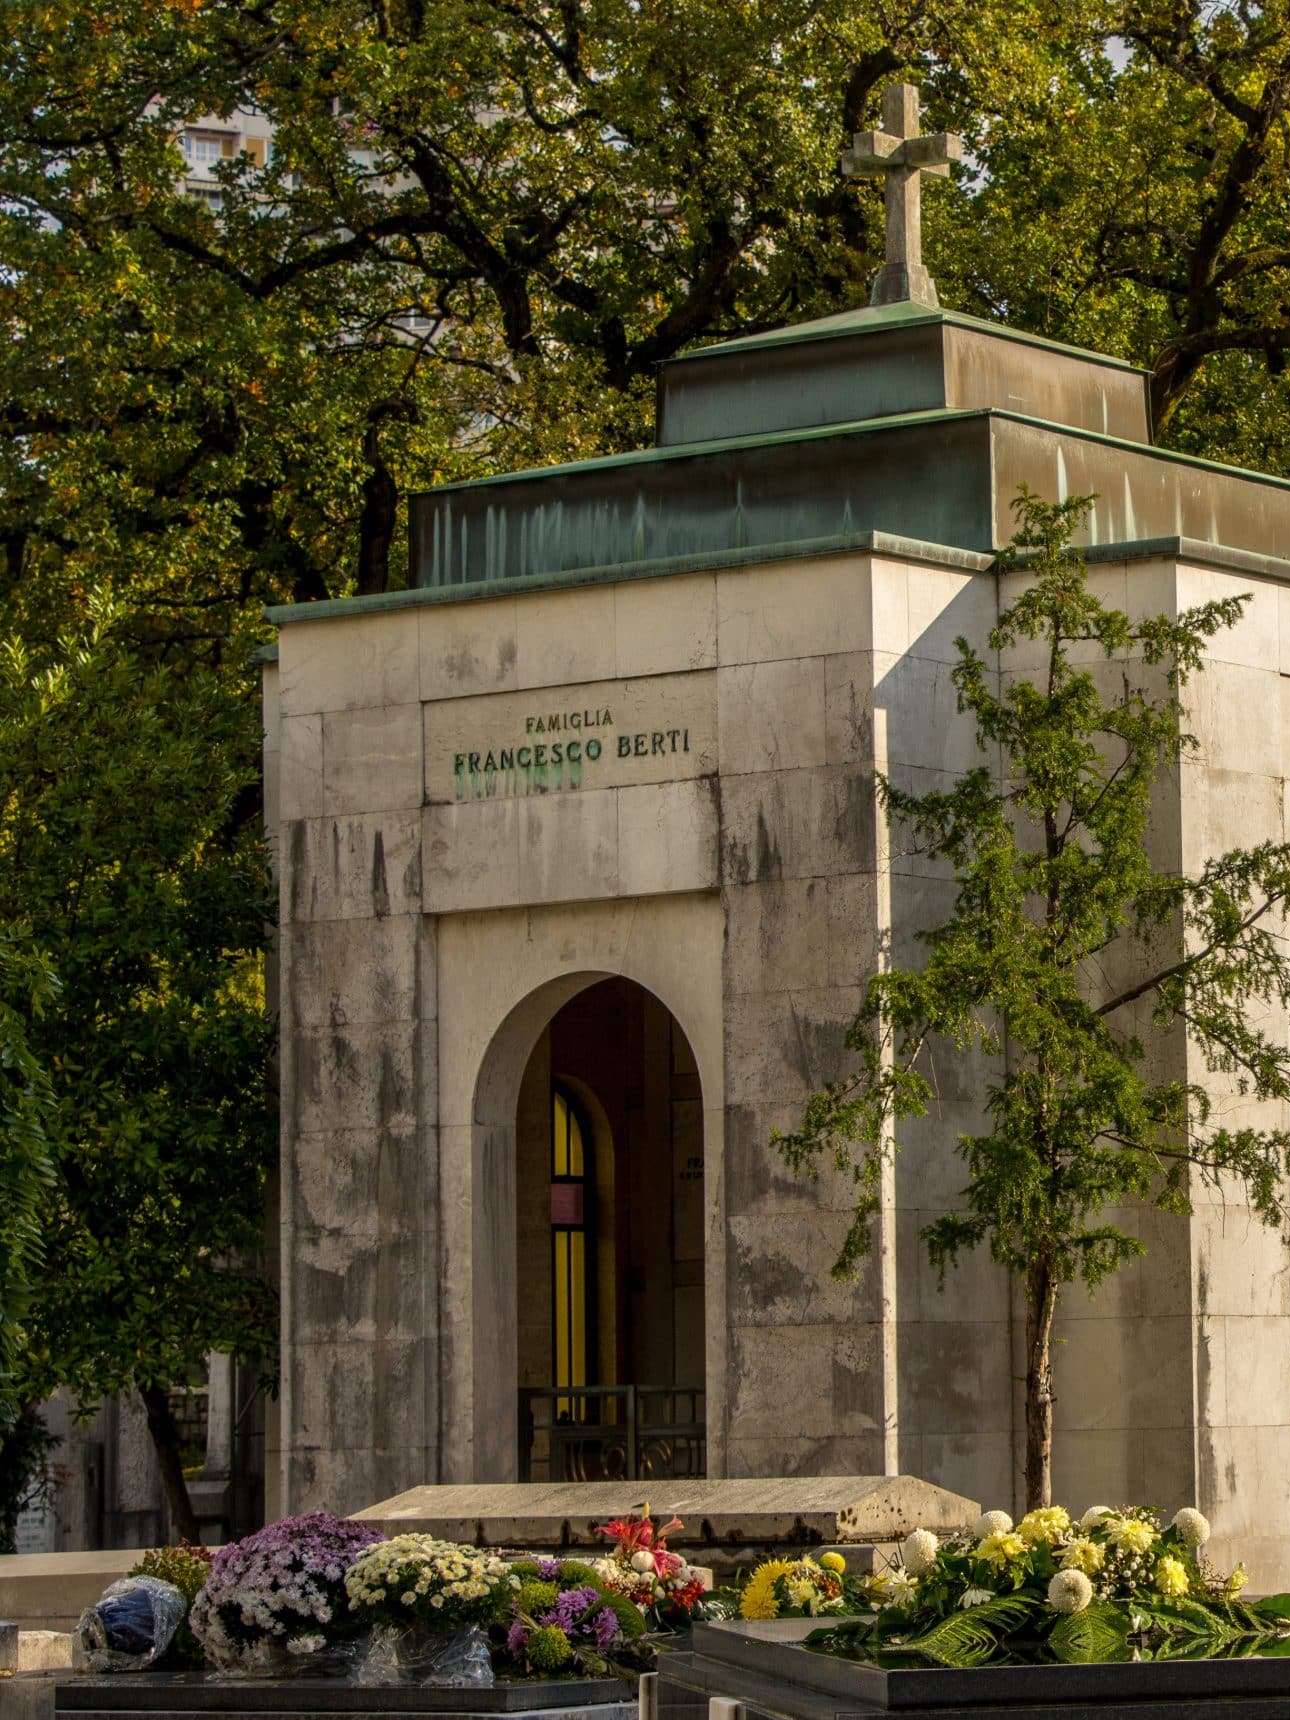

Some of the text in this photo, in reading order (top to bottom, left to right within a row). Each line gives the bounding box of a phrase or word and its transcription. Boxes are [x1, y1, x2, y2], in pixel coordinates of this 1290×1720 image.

[525, 708, 614, 734] FAMIGLIA
[453, 728, 690, 776] FRANCESCO BERTI
